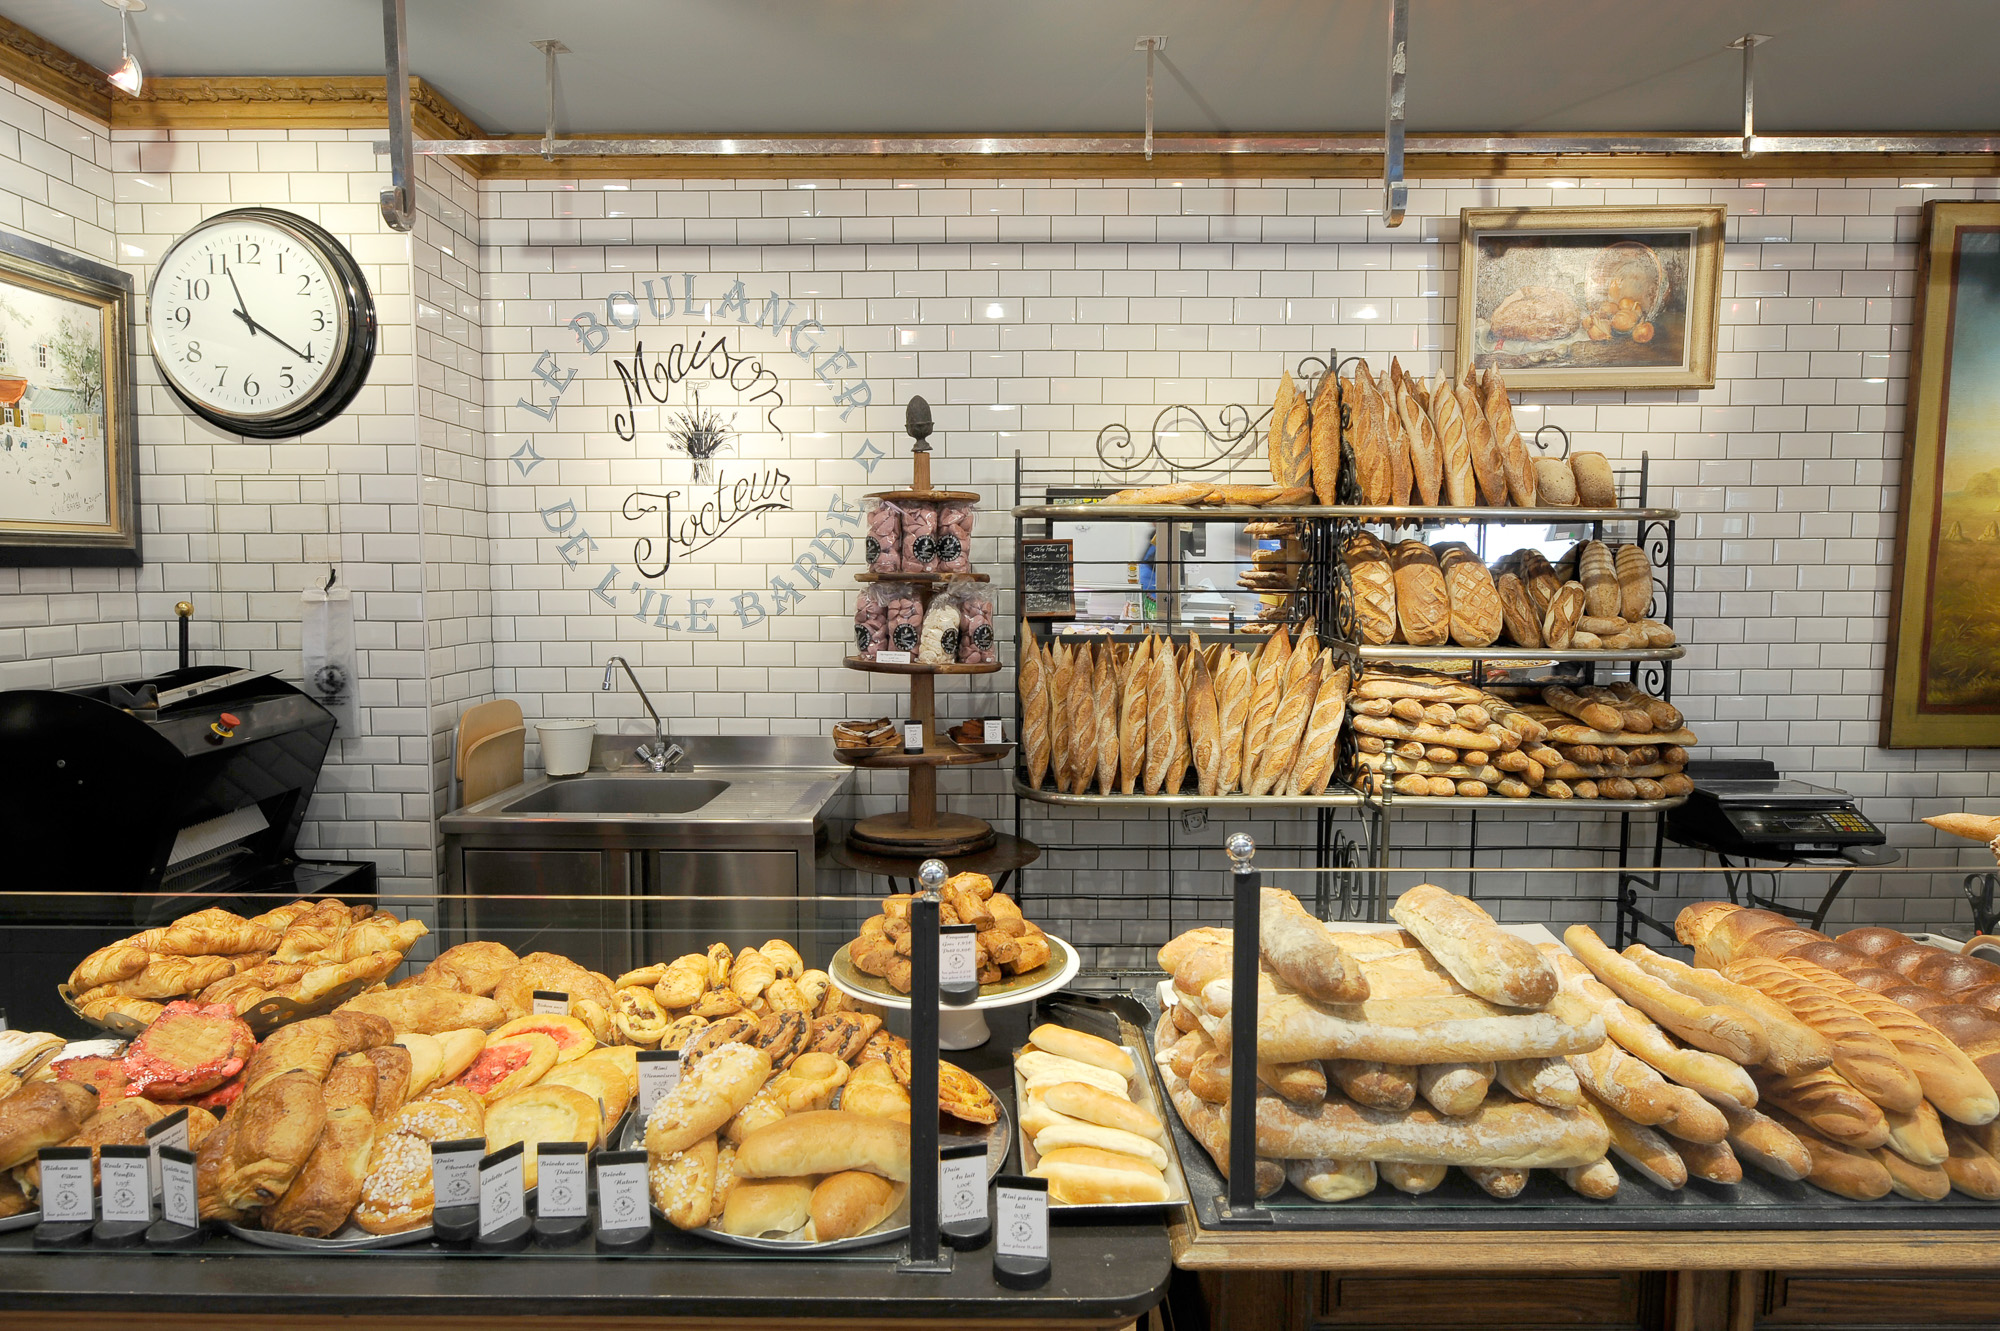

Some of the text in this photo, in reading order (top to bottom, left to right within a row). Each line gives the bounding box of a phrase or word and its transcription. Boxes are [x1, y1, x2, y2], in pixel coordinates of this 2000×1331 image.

[208, 253, 229, 275] 11
[235, 243, 261, 265] 12
[276, 252, 286, 275] 1
[184, 278, 210, 301] 10
[297, 274, 311, 297] 2
[174, 306, 191, 331] 9
[310, 309, 325, 332] 3
[186, 340, 202, 363] 8
[299, 340, 315, 364] 4
[516, 273, 873, 423] LE BOULANGER
[214, 365, 229, 387] 7
[243, 372, 260, 397] 6
[279, 365, 294, 389] 5
[612, 330, 784, 442] Maison
[622, 468, 793, 578] Jocteur
[539, 493, 865, 633] DE L'ILE BARBE
[943, 1166, 960, 1174] Pain
